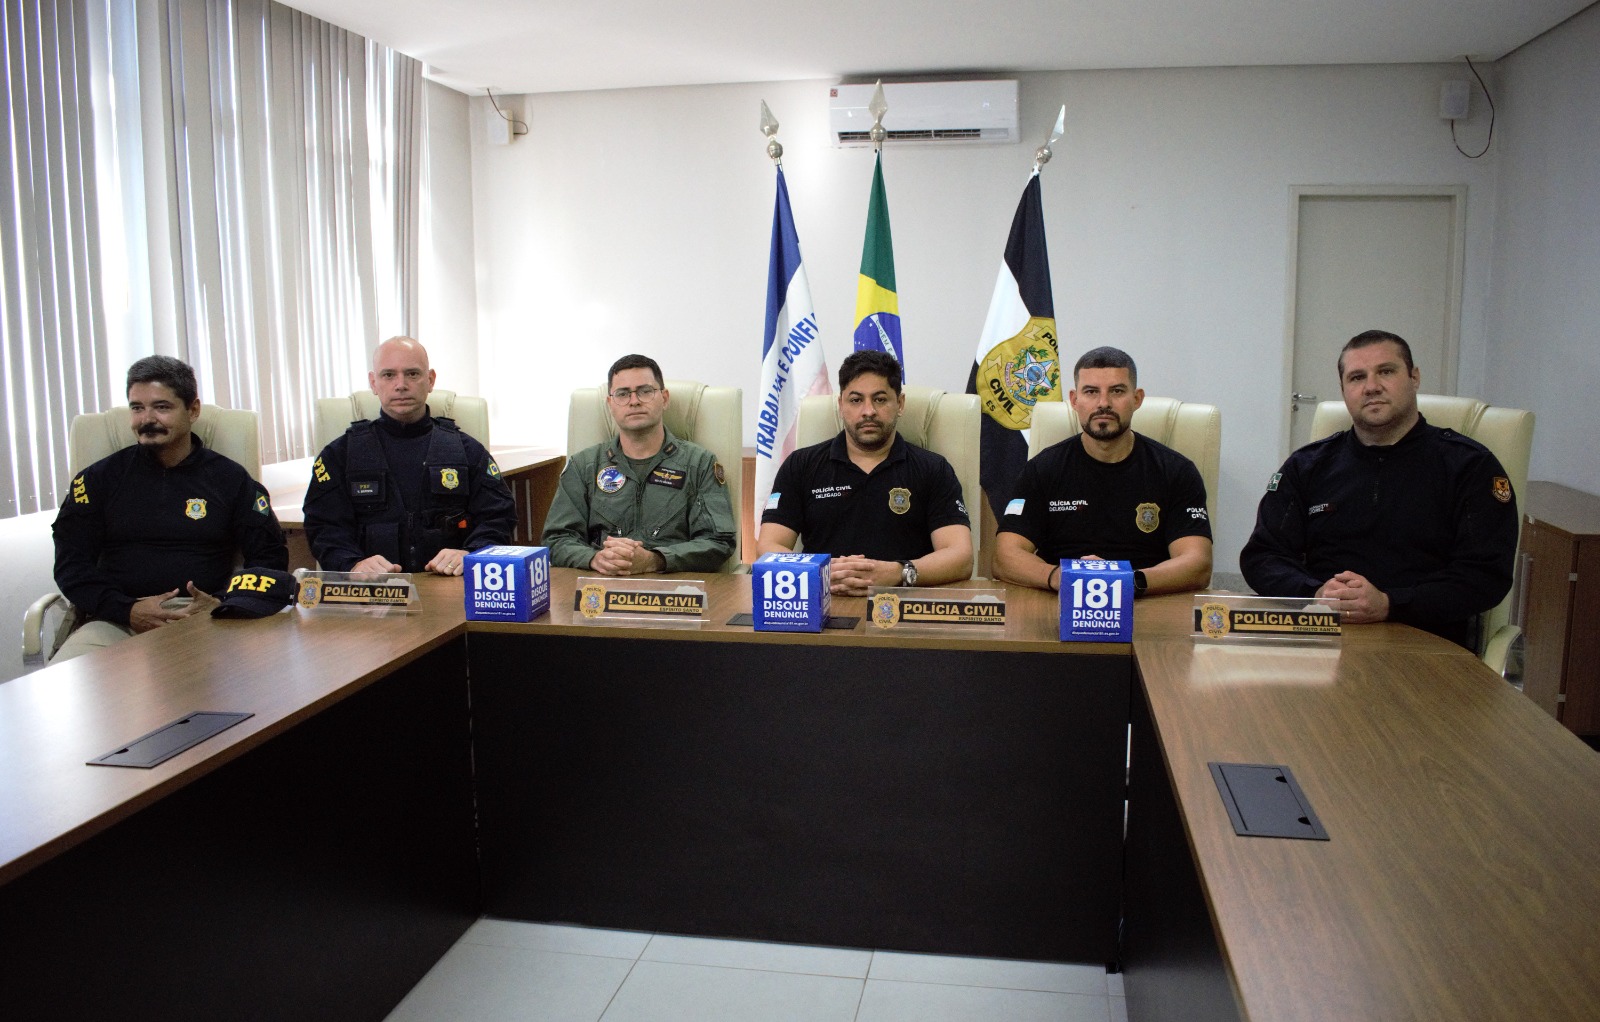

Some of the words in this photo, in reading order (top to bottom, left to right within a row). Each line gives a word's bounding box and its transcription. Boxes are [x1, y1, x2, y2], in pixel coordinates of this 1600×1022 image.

[782, 312, 819, 364] CONFI
[777, 359, 790, 374] E
[989, 378, 1015, 415] CIVIL
[986, 400, 996, 412] ES
[314, 456, 331, 483] PRF
[74, 475, 90, 504] PRF
[1049, 499, 1071, 507] OLÍCIA
[471, 562, 516, 591] 181
[529, 554, 548, 588] 181
[226, 573, 277, 594] PRF
[531, 582, 548, 599] DISQUE
[761, 570, 809, 600] 181
[324, 584, 372, 597] POLÍCIA
[374, 587, 406, 598] CIVIL
[474, 591, 516, 602] DISQUE
[1071, 578, 1122, 609] 181
[475, 600, 516, 609] DENÚNCIA
[609, 593, 661, 606] POLÍCIA
[664, 596, 700, 607] CIVIL
[763, 600, 809, 611] DISQUE
[764, 610, 809, 619] DENÚNCIA
[903, 602, 960, 615] POLÍCIA
[964, 605, 1002, 616] CIVIL
[1072, 609, 1121, 620] DISQUE
[1072, 620, 1121, 629] DENÚNCIA
[1234, 612, 1294, 625] POLÍCIA
[1298, 615, 1338, 626] CIVIL
